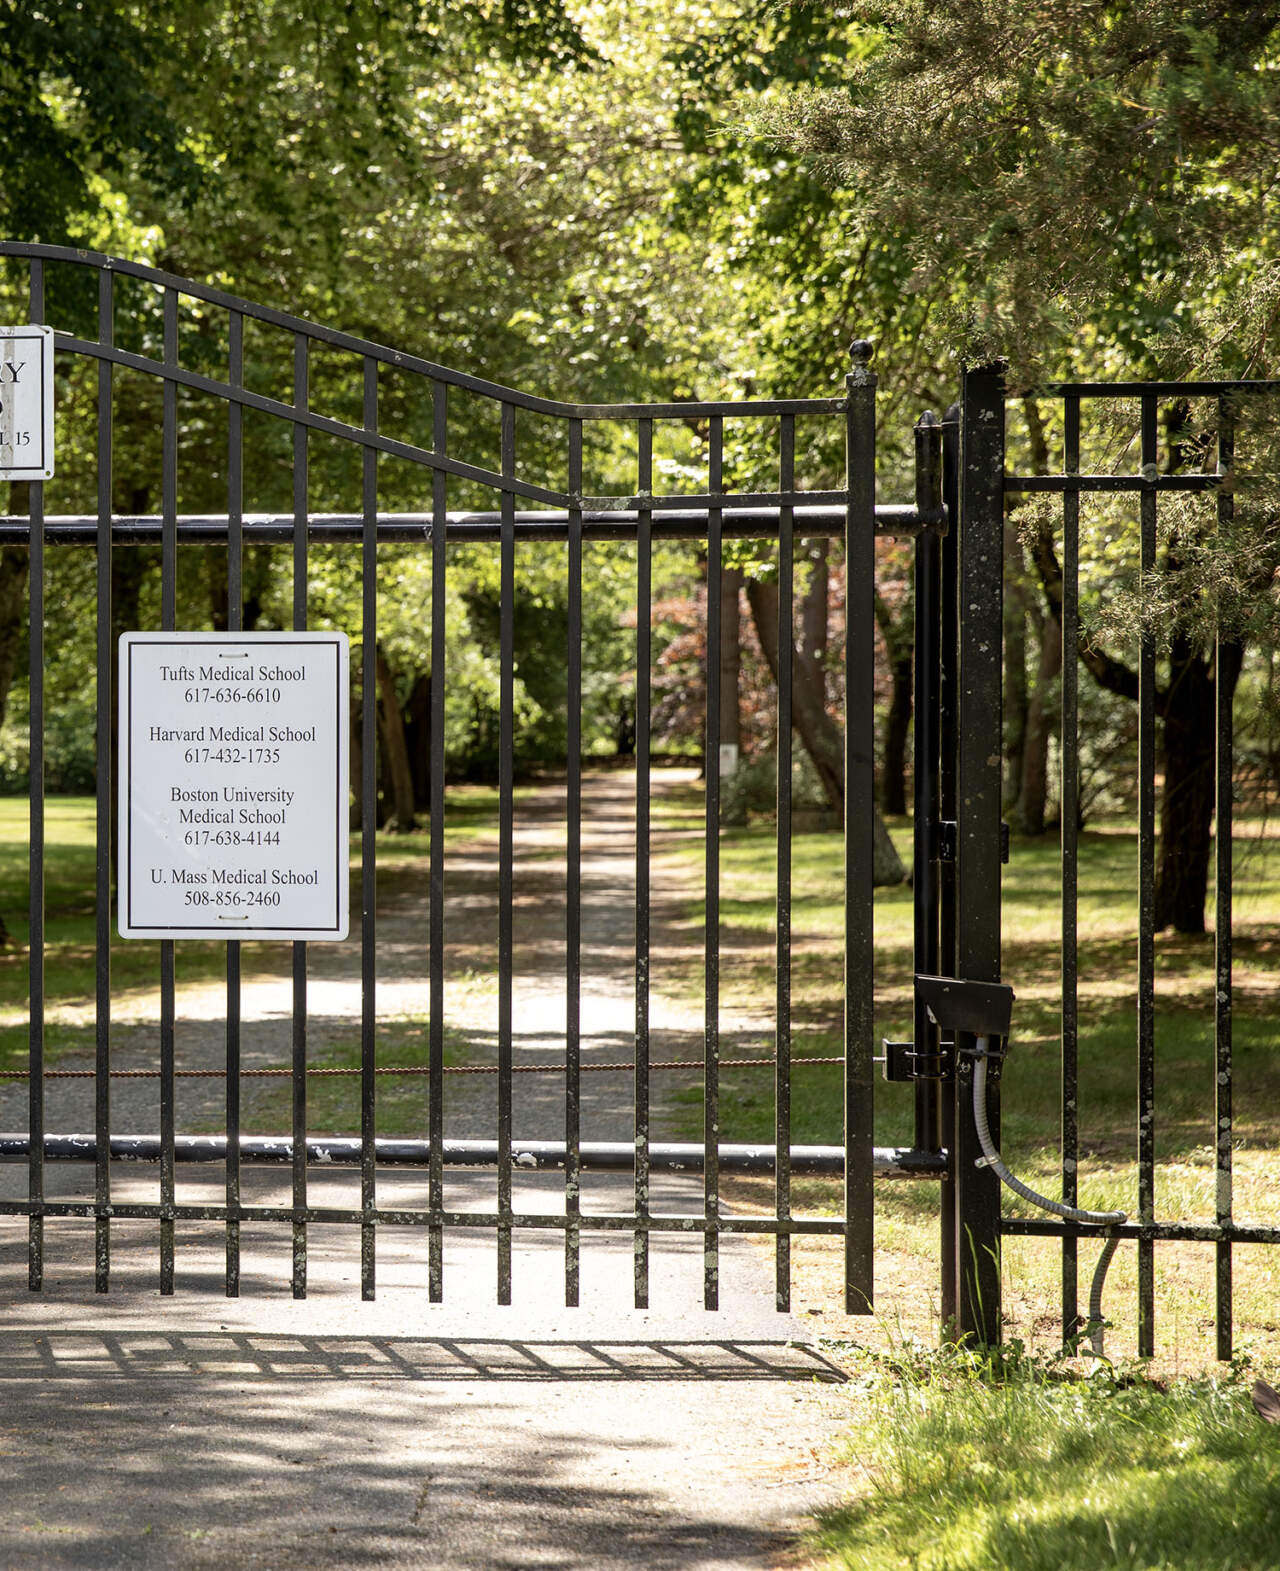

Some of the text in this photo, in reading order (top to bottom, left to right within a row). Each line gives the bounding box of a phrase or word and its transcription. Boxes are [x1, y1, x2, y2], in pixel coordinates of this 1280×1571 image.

[16, 432, 30, 446] 15
[159, 666, 305, 681] Tufts Medical School
[184, 688, 281, 703] 617-636-6610
[149, 727, 316, 742] Harvard Medical School
[184, 749, 280, 764] 617-432-1735
[171, 787, 295, 806] Boston University
[179, 809, 286, 824] Medical School
[184, 831, 281, 846] 617-638-4144
[151, 869, 318, 885] U. Mass Medical School
[184, 891, 281, 906] 508-856-2460
